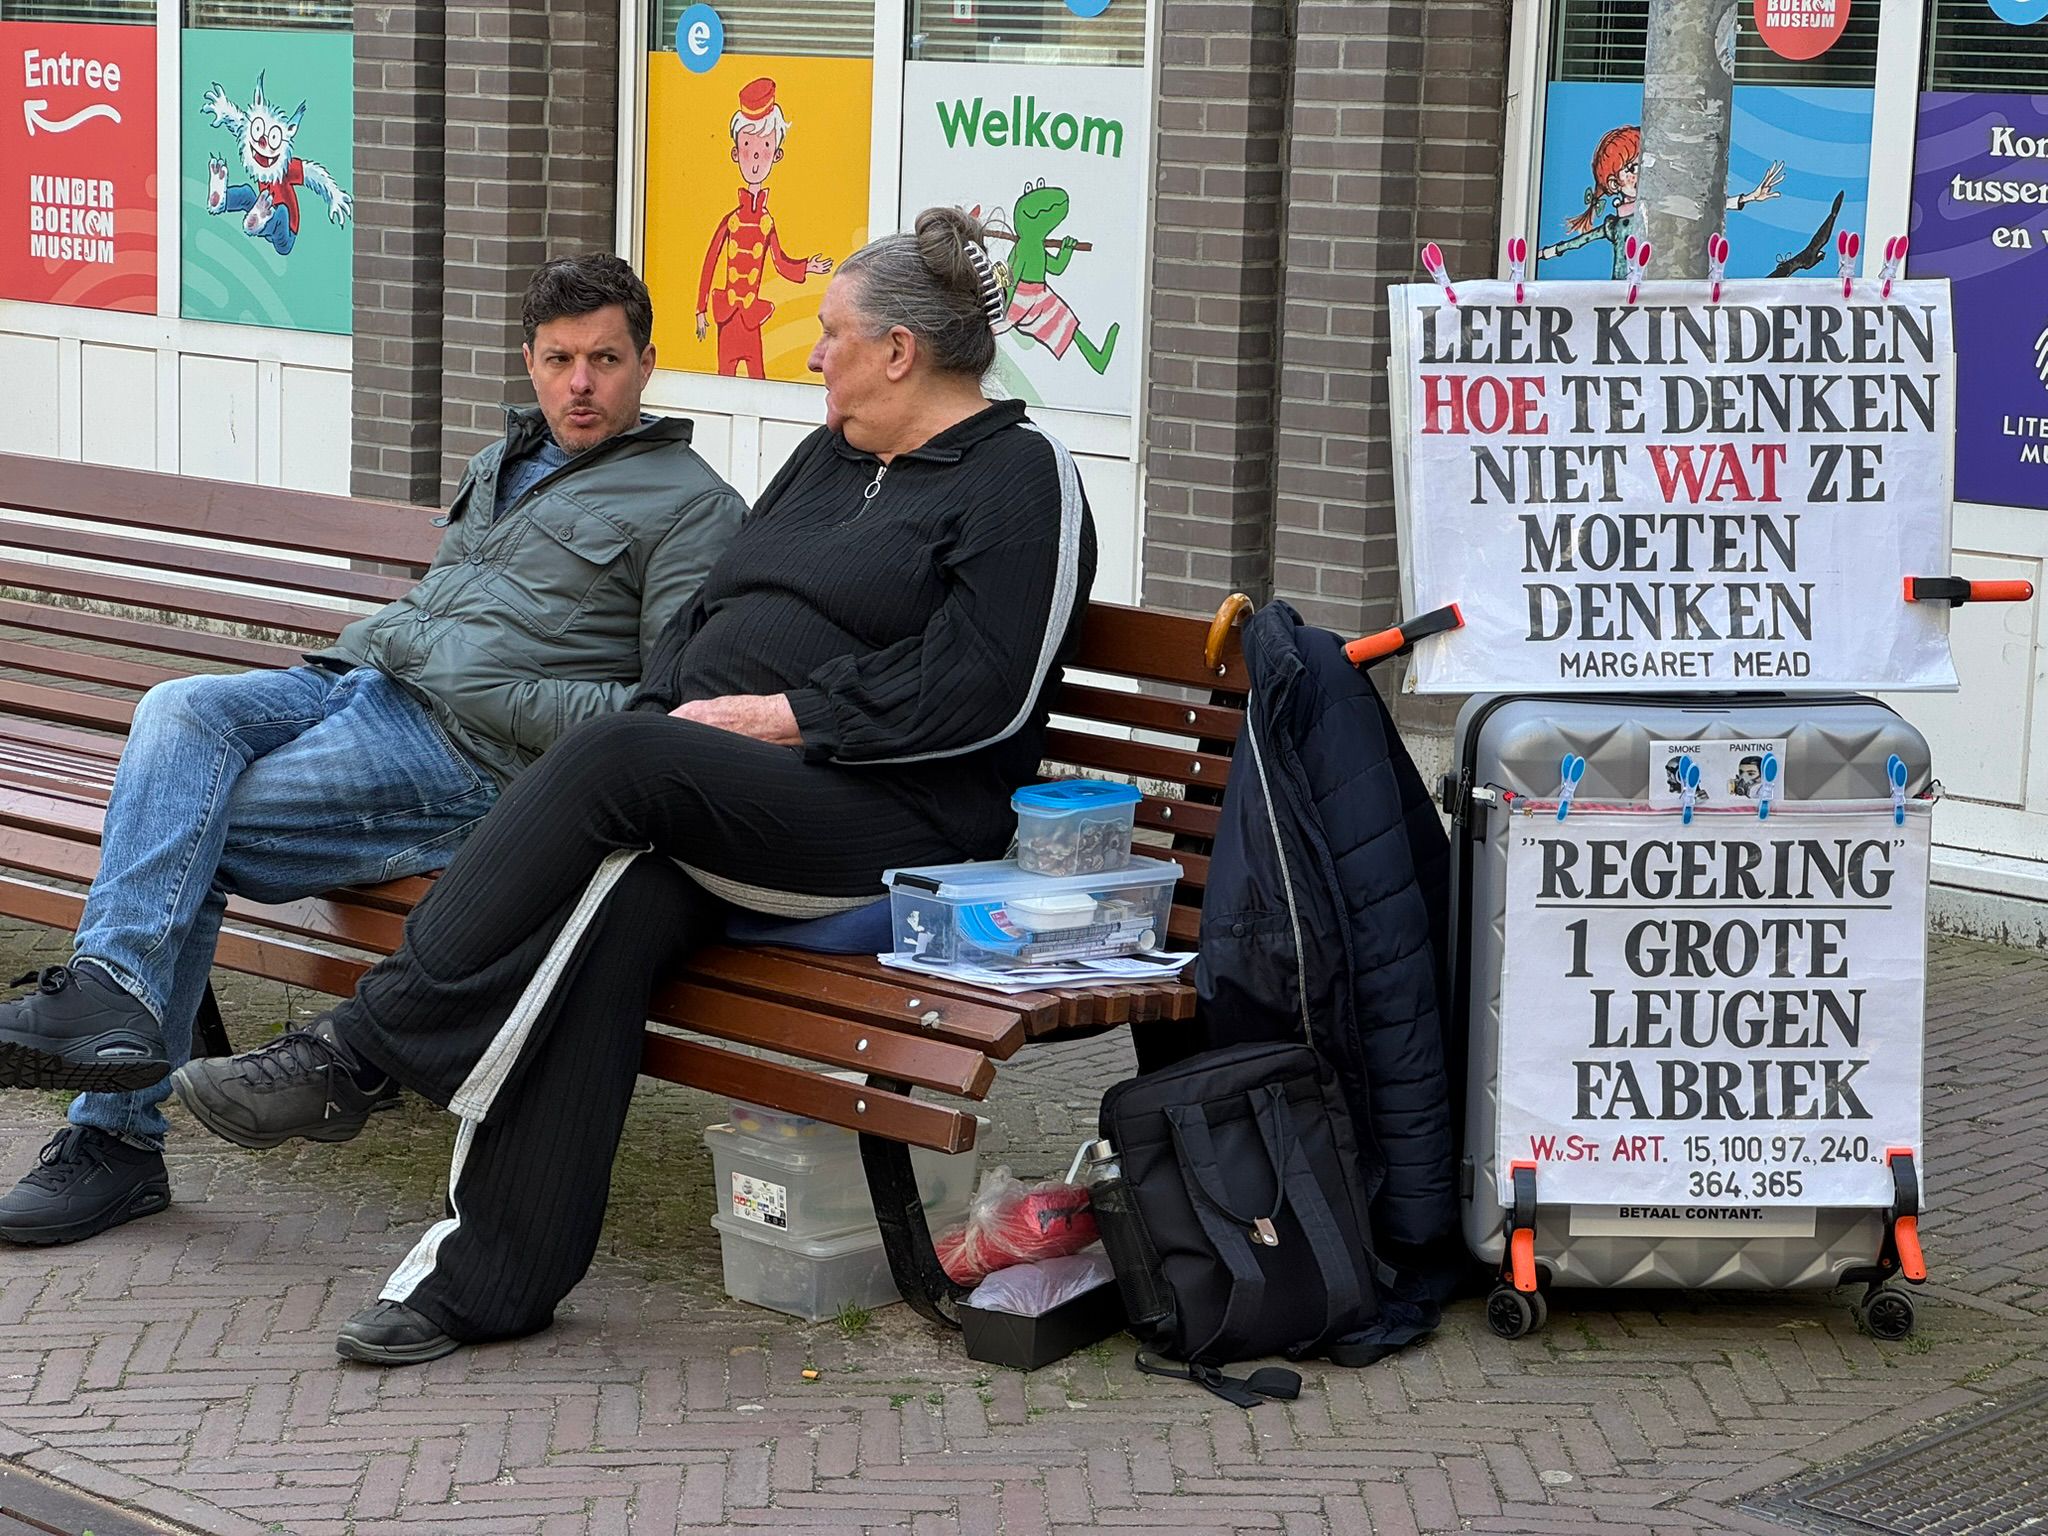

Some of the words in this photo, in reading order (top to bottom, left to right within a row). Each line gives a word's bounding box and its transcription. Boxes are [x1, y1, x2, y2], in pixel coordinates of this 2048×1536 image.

[1766, 13, 1835, 28] MUSEUM
[24, 49, 121, 92] Entree
[936, 95, 1123, 158] Welkom
[30, 174, 114, 209] KINDER
[30, 205, 114, 238] BOEKON
[1992, 226, 2032, 249] en
[30, 233, 114, 264] MUSEUM
[1417, 305, 1578, 364] LEER
[1592, 305, 1937, 365] KINDEREN
[1420, 375, 1549, 435] HOE
[1561, 375, 1646, 434] TE
[1659, 373, 1941, 434] DENKEN
[1470, 445, 1627, 505] NIET
[1645, 442, 1787, 504] WAT
[1806, 444, 1886, 503] ZE
[1518, 513, 1801, 573] MOETEN
[1522, 582, 1816, 642] DENKEN
[1560, 651, 1714, 678] MARGARET
[1733, 651, 1811, 677] MEAD
[1668, 745, 1701, 753] SMOKE
[1729, 743, 1773, 752] PAINTING
[1564, 919, 1594, 978] 1
[1624, 919, 1848, 979] GROTE
[1588, 988, 1867, 1049] LEUGEN
[1571, 1059, 1874, 1121] FABRIEK
[1612, 1135, 1668, 1163] ART.
[1619, 1207, 1680, 1219] BETAAL
[1685, 1207, 1763, 1220] CONTANT.
